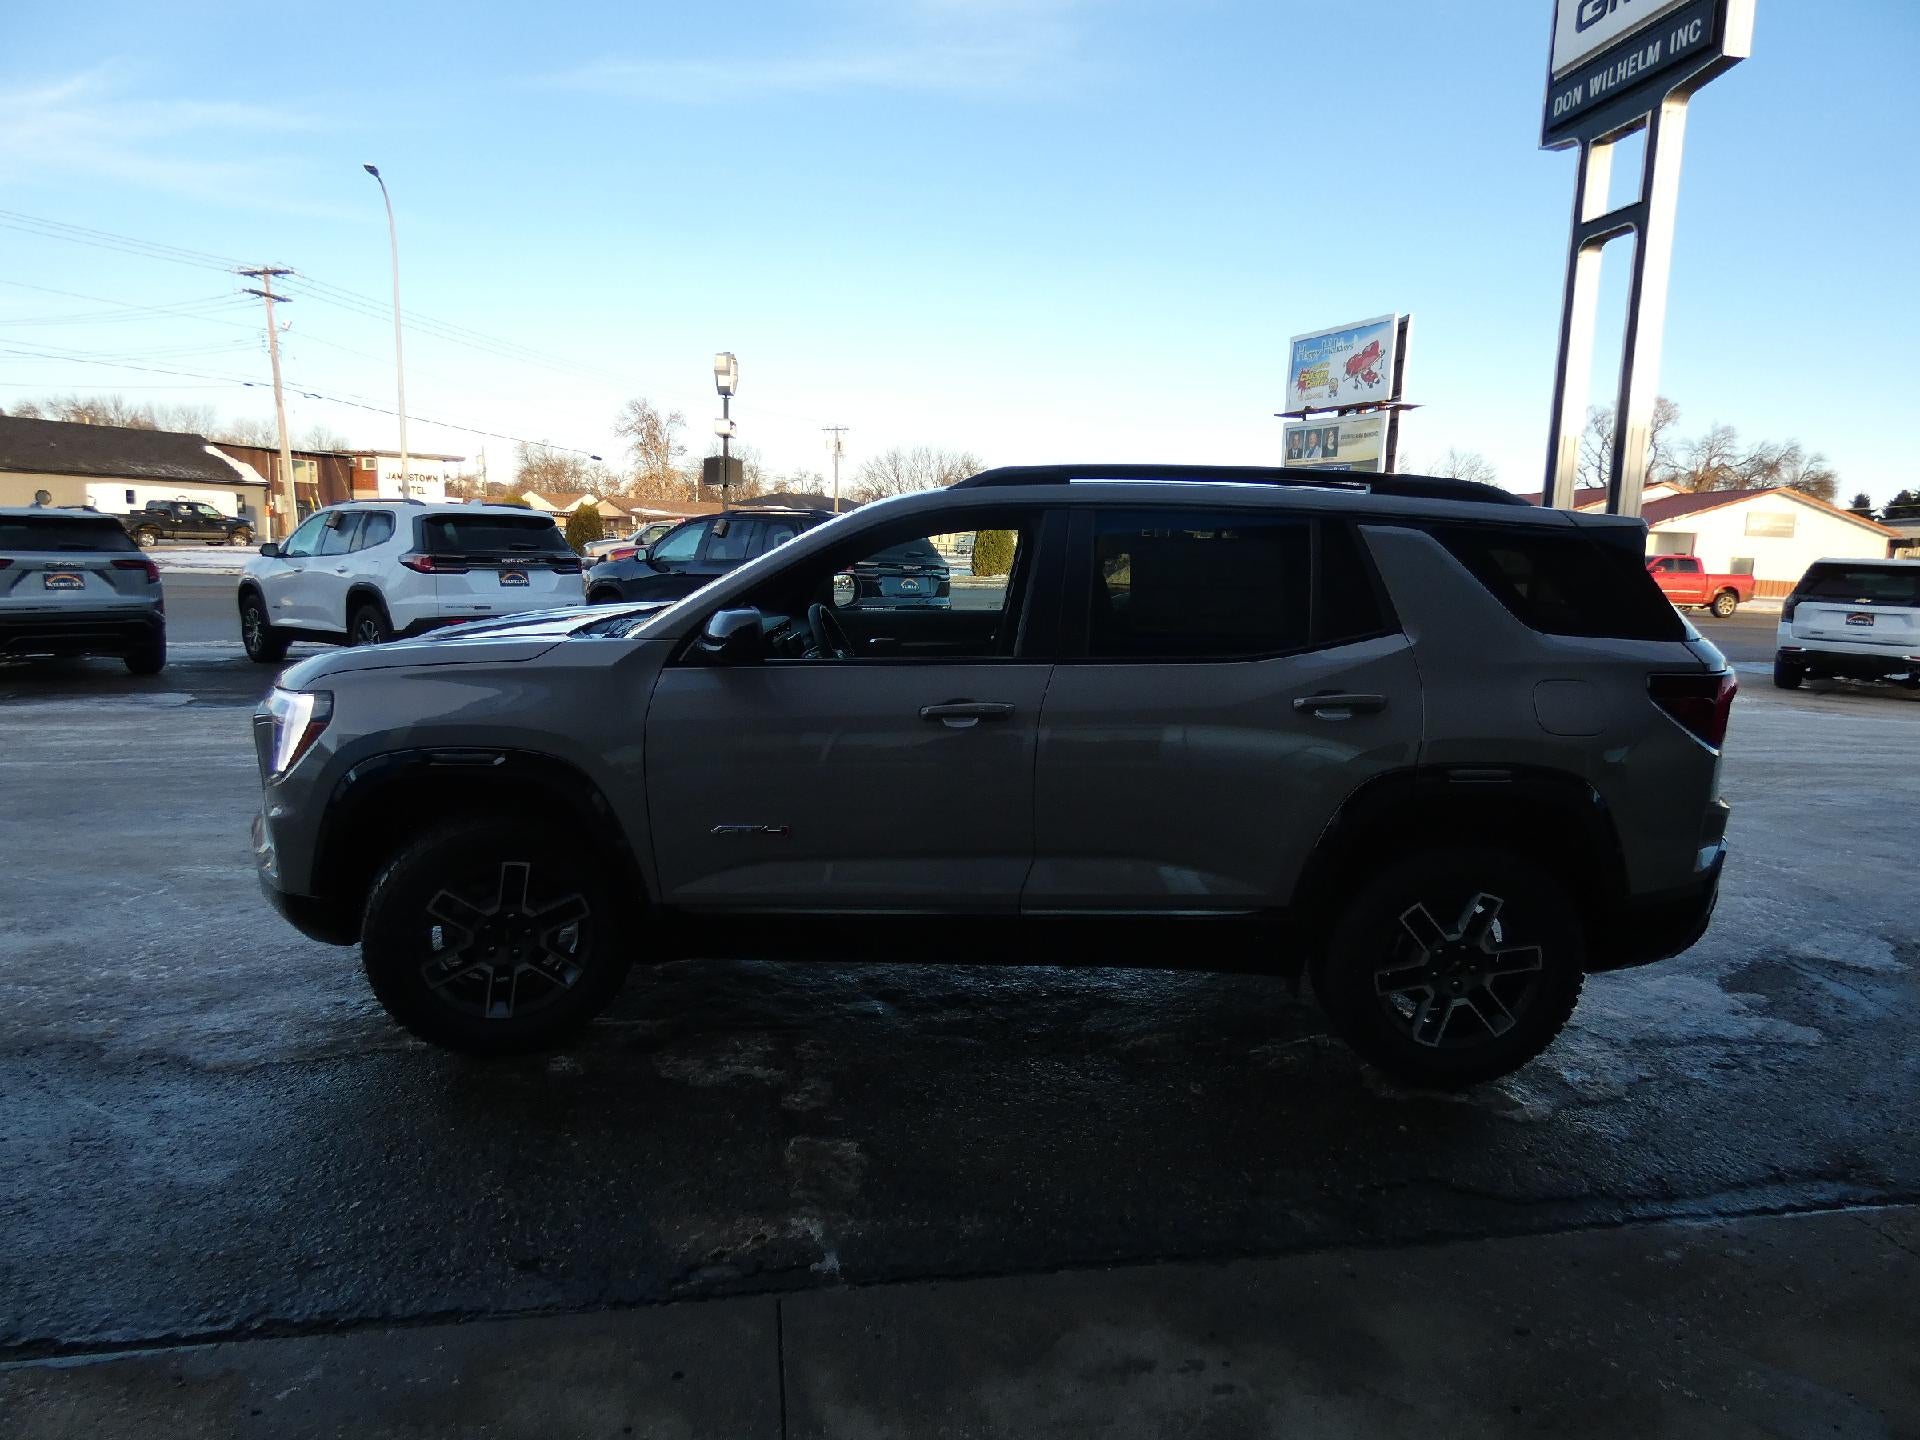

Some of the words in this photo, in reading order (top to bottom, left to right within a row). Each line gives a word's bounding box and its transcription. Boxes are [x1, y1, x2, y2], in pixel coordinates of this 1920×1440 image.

[1553, 85, 1582, 117] DON
[1589, 40, 1660, 98] WILHELM
[1669, 18, 1702, 54] INC
[386, 472, 439, 482] JAMSTOWN
